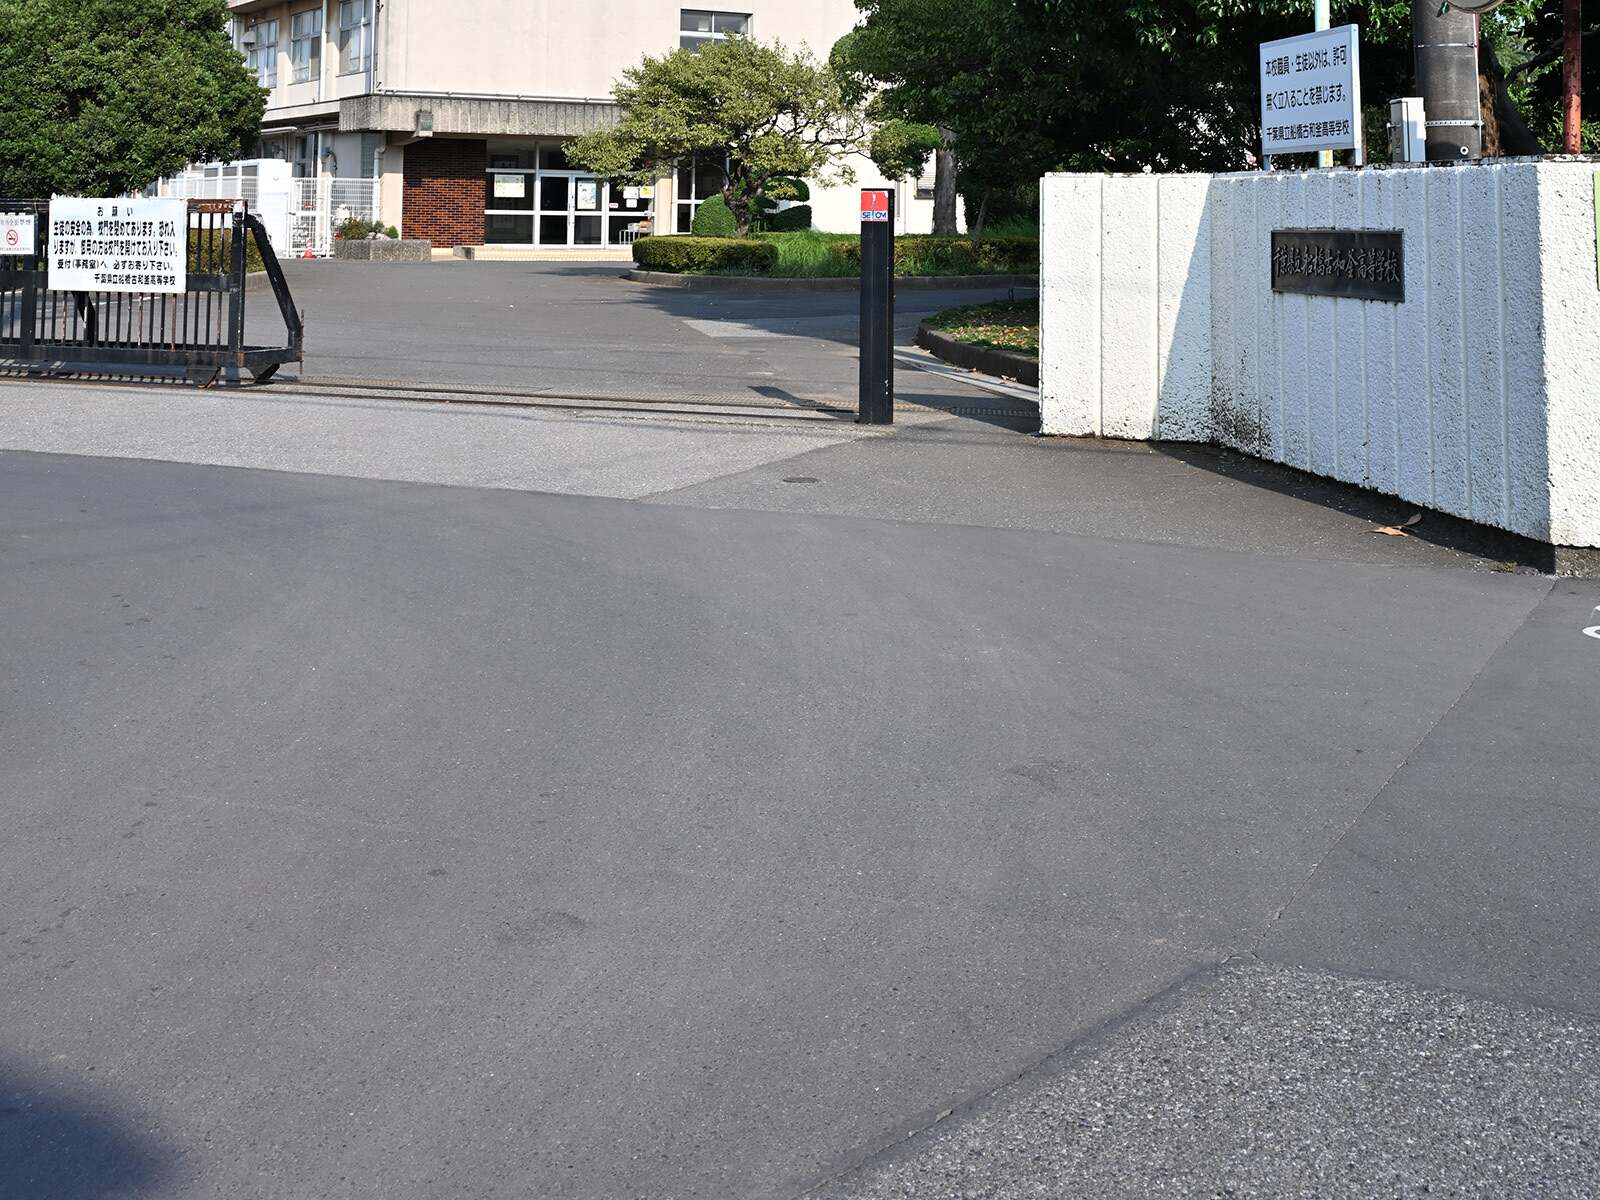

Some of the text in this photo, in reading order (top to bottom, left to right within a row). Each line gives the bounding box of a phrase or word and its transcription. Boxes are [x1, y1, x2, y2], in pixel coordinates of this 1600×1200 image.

[1266, 120, 1350, 141] 千葉県立船橋古和釜高等学校
[862, 211, 887, 219] SEOM
[94, 273, 175, 285] 千葉県立船橋古和釜高等学校
